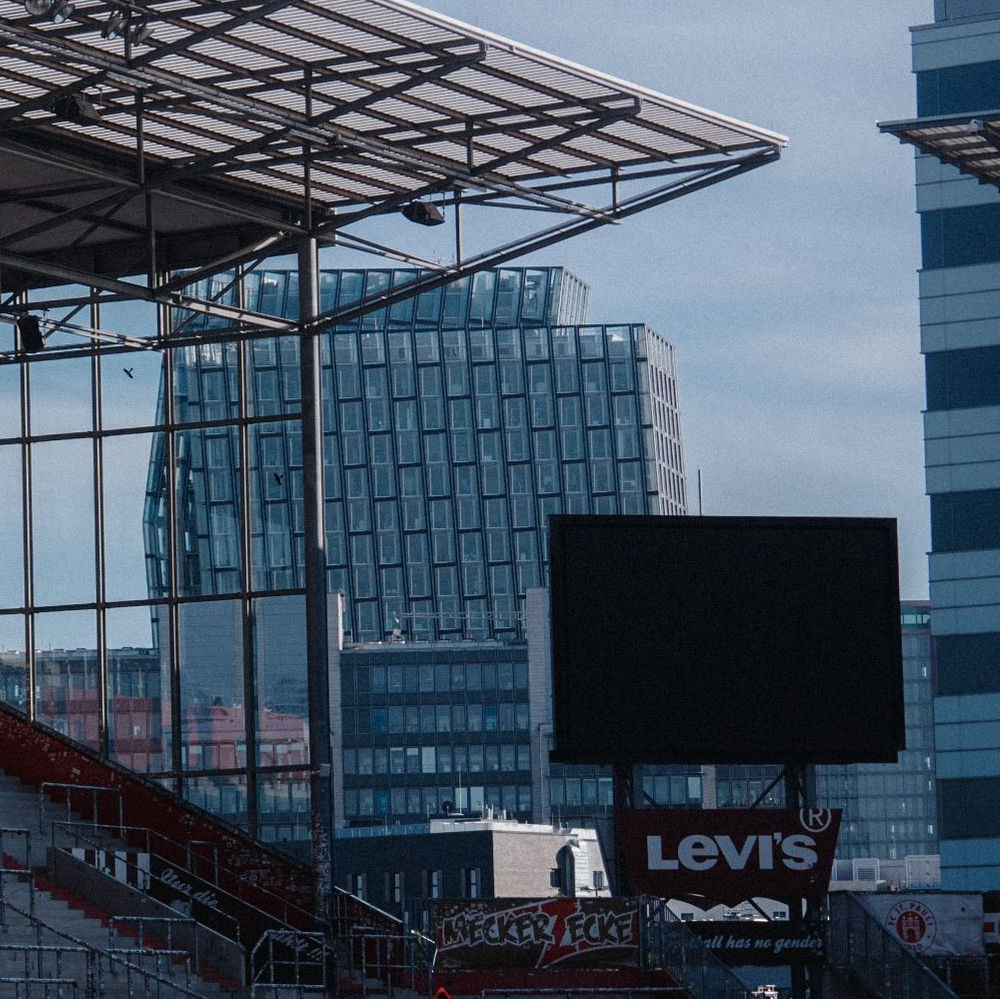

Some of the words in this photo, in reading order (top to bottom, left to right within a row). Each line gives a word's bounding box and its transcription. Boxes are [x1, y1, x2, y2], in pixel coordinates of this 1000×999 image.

[442, 911, 556, 947] MECKER
[562, 910, 634, 947] ECKE
[725, 934, 752, 950] has
[754, 938, 772, 950] no
[773, 934, 824, 955] gender
